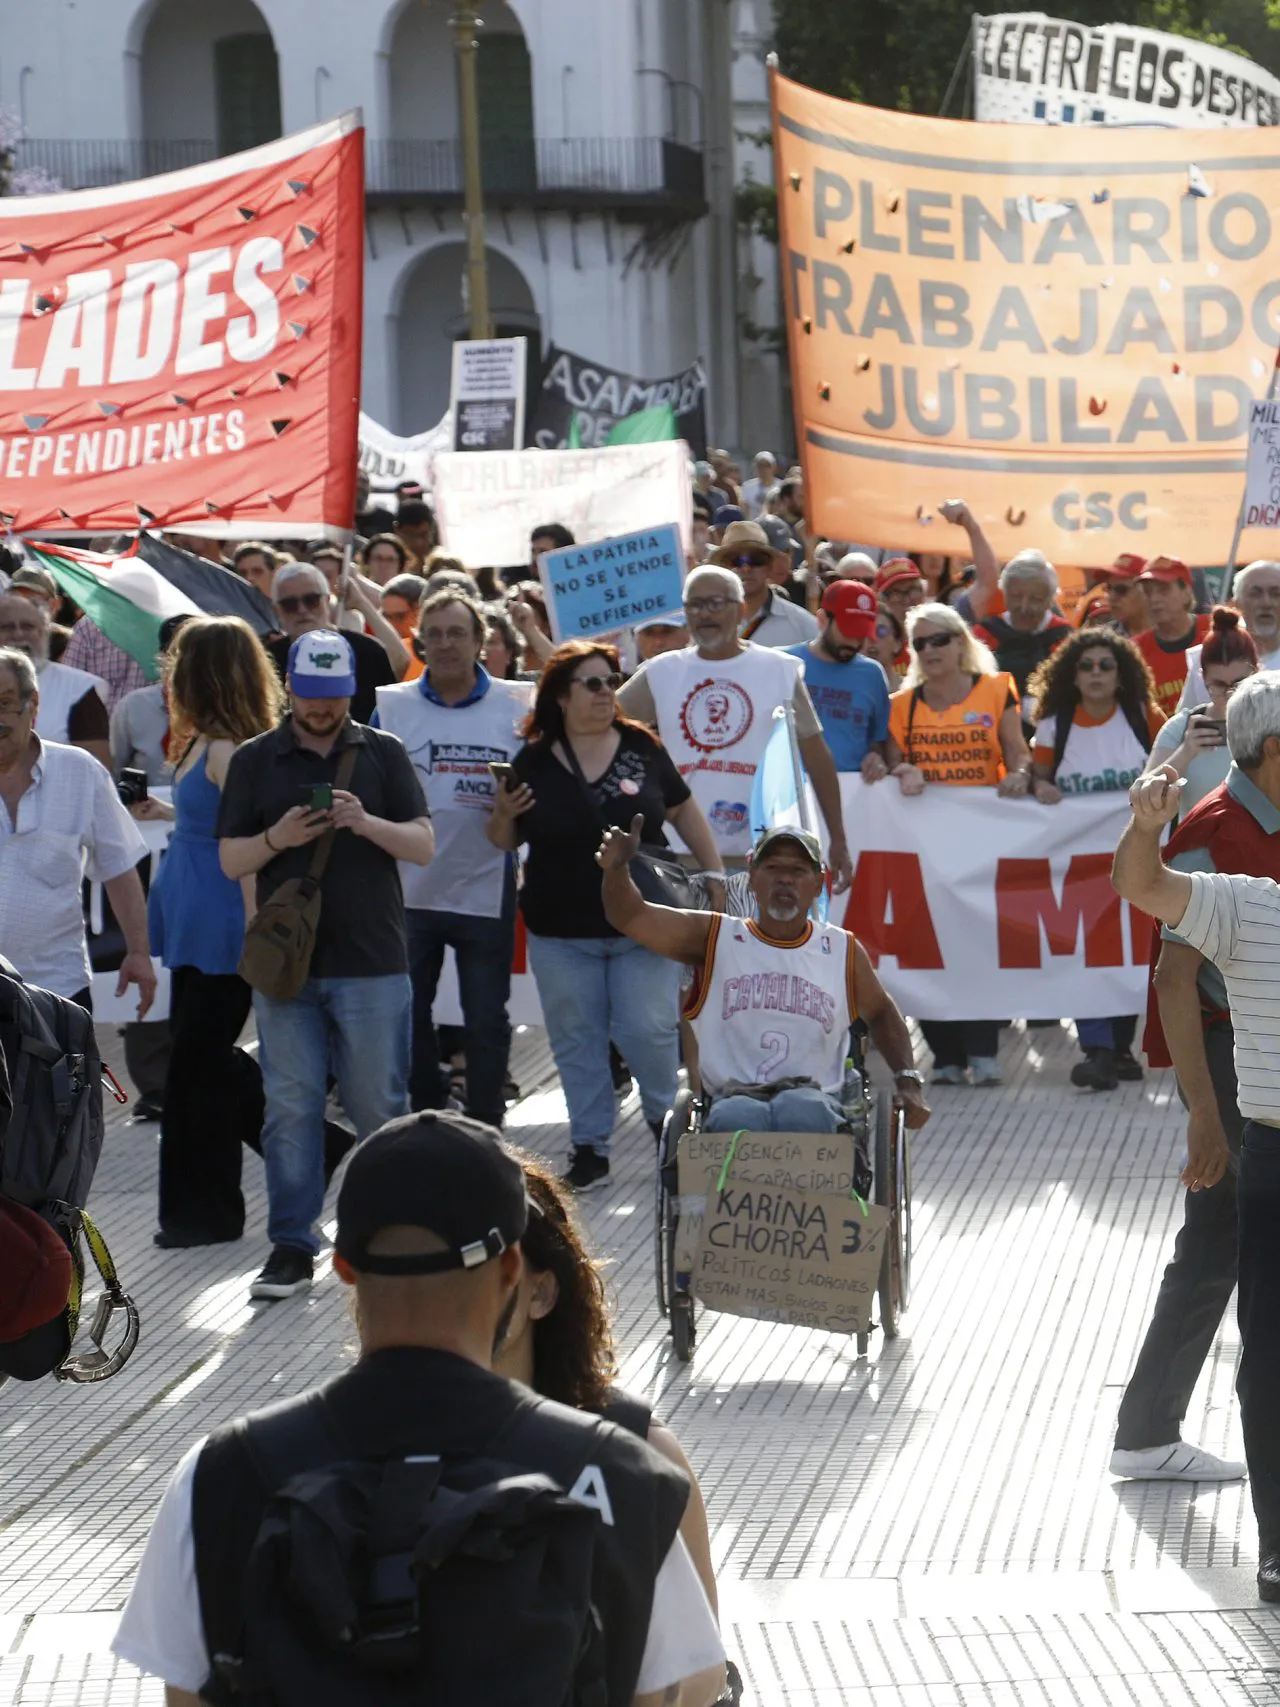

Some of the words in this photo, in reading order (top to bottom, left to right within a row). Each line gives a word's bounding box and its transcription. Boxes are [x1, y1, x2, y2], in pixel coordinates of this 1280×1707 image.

[813, 166, 1273, 266] PLENARIO
[1252, 427, 1277, 445] ME
[1051, 490, 1148, 532] CSC
[563, 553, 589, 571] LA
[591, 536, 660, 565] PATRIA
[553, 578, 580, 596] NO
[585, 567, 608, 585] SE
[613, 552, 673, 580] VENDE
[603, 584, 629, 602] SE
[578, 594, 668, 630] DEFIENDE
[970, 730, 989, 742] DE
[722, 971, 836, 1035] CAVALIERS
[755, 1030, 790, 1083] 2
[816, 1148, 839, 1161] EN
[716, 1189, 828, 1233] KARINA
[708, 1221, 830, 1263] CHORRA
[694, 1278, 742, 1296] ESTAN
[799, 1268, 869, 1294] LADRONES
